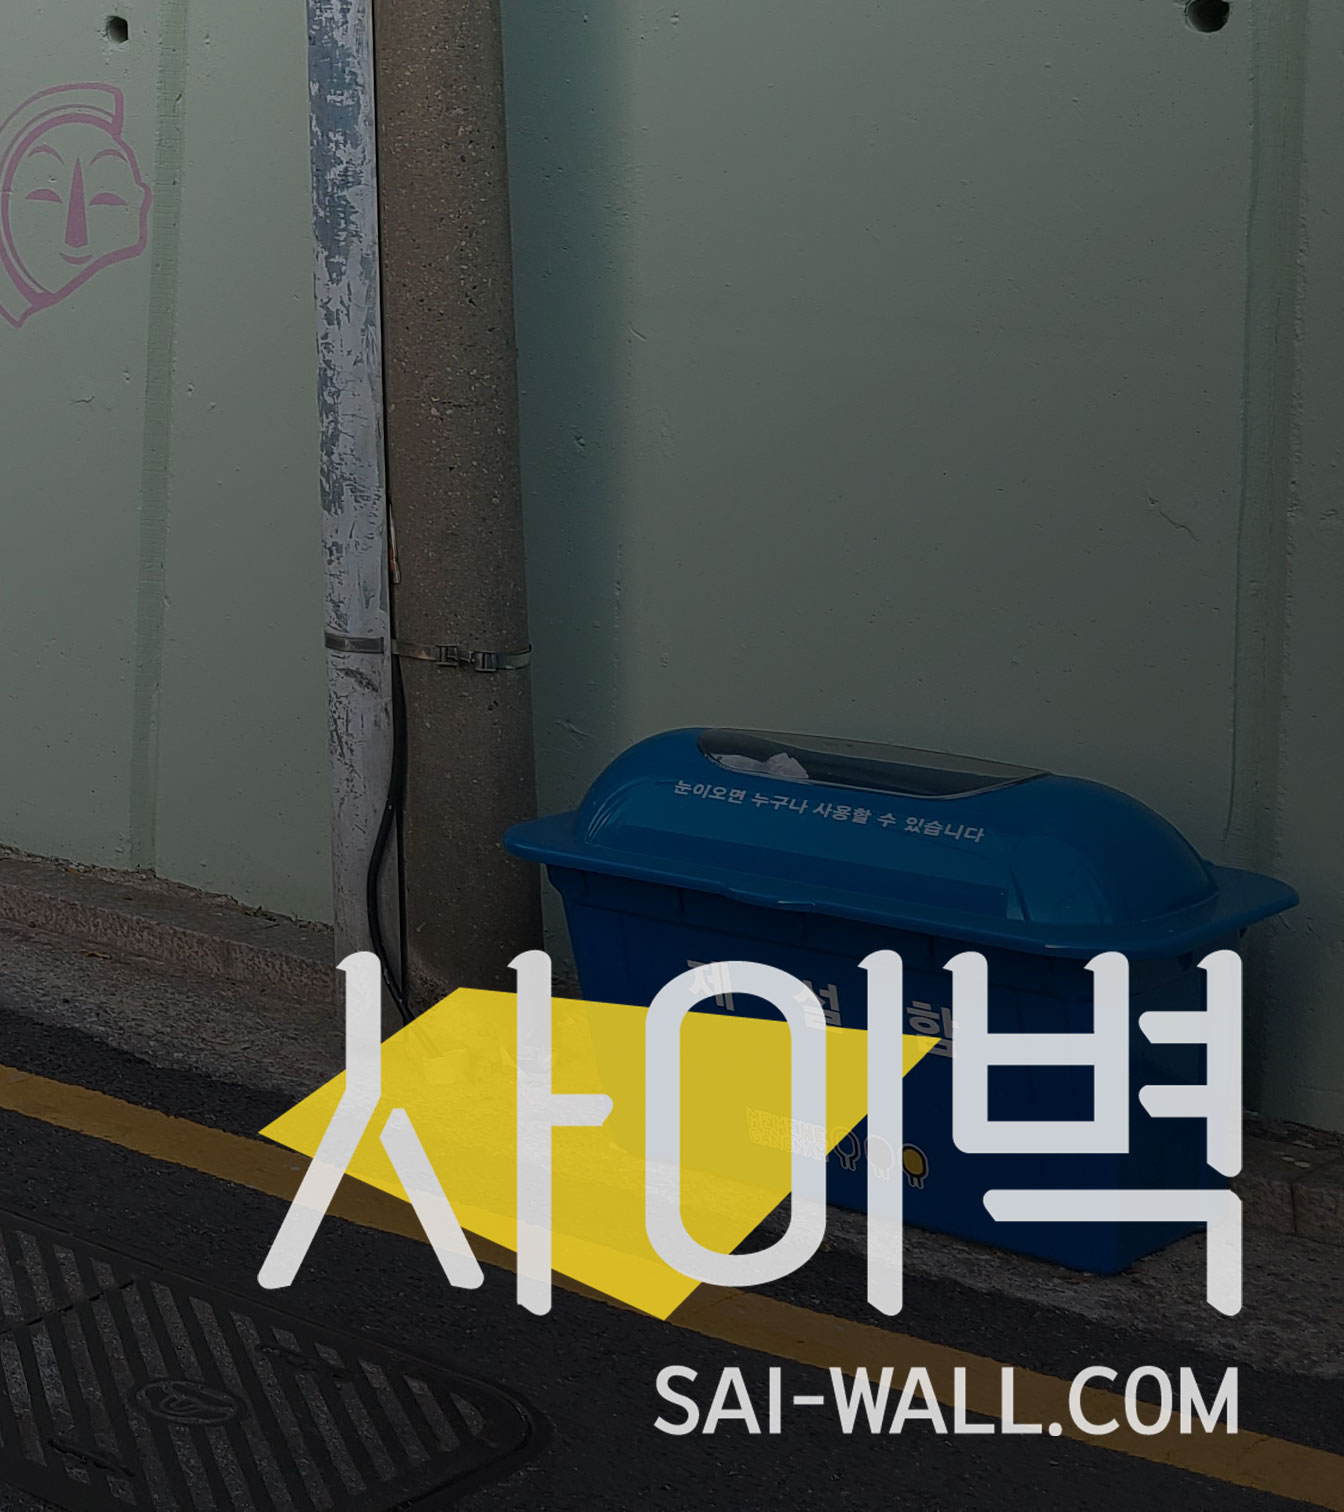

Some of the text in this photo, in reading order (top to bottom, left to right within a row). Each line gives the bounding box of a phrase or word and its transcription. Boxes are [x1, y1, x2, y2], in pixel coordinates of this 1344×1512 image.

[673, 779, 986, 843] 눈이오면 누구나 사용할 수 있습니다
